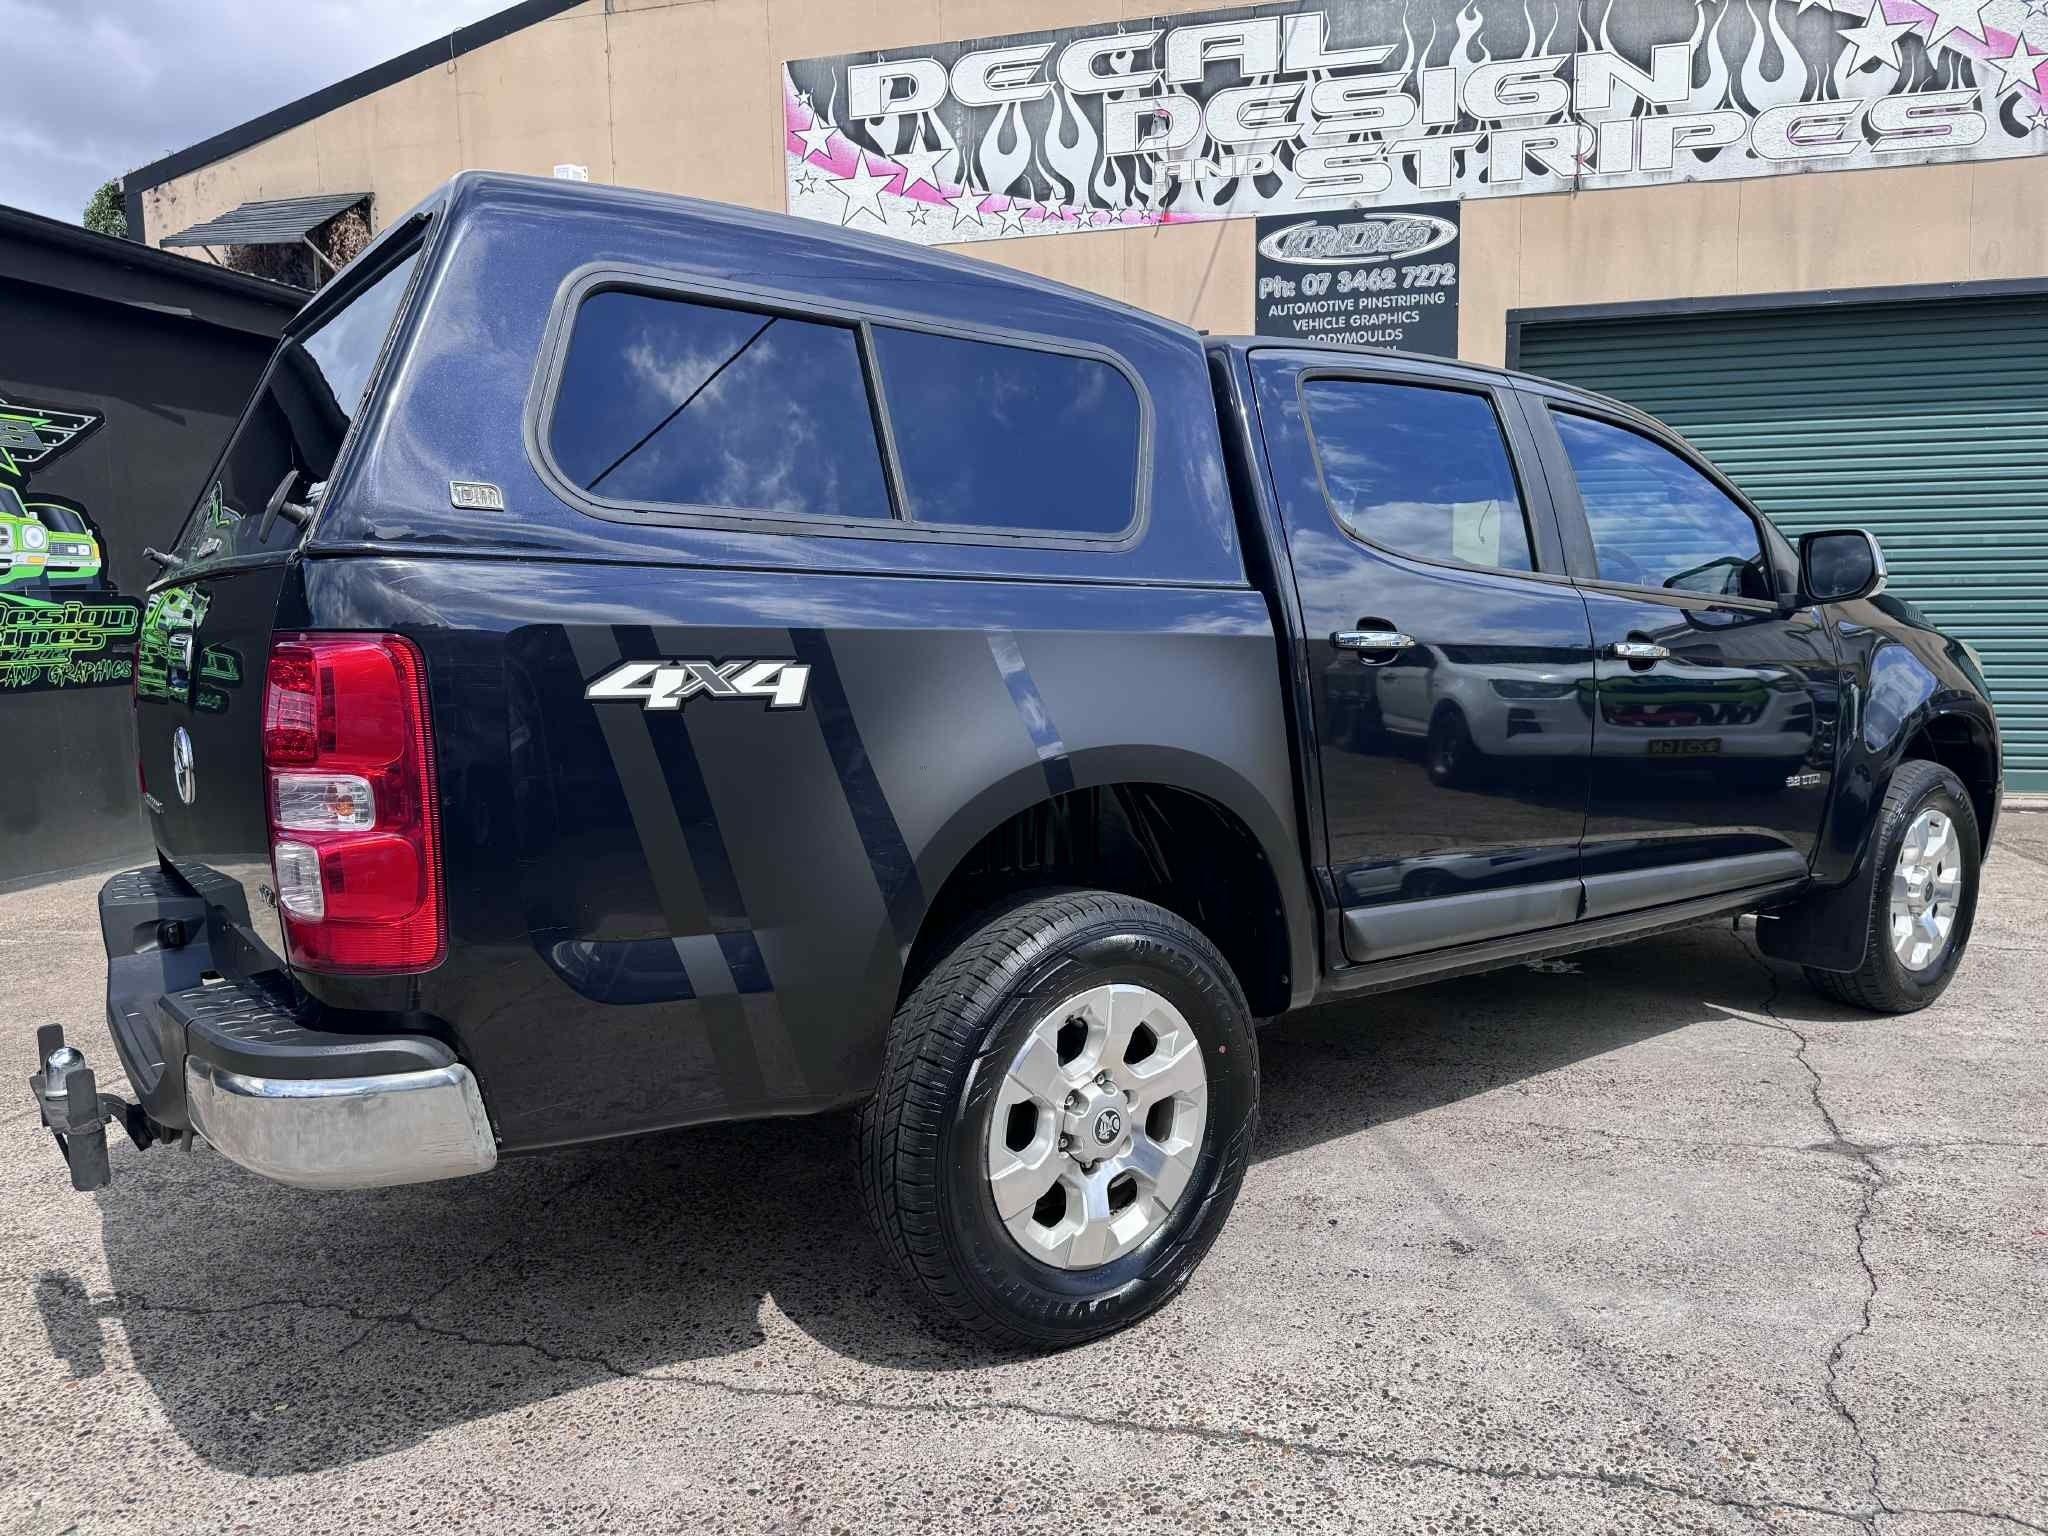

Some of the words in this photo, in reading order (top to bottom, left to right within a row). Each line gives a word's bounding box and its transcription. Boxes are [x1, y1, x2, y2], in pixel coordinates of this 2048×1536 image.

[847, 11, 1400, 120] DECAL
[1104, 42, 1694, 157] DESIGN
[1293, 88, 1988, 200] STRIPES
[1259, 275, 1296, 299] Ph:
[1301, 272, 1332, 296] 07
[1337, 267, 1397, 293] 3462
[1401, 262, 1456, 288] 7272
[1268, 298, 1355, 317] AUTOMOTIVE
[1359, 292, 1446, 310] PINSTRIPING
[1293, 316, 1346, 332] VEHICLE
[1350, 310, 1420, 327] GRAPHICS
[0, 603, 138, 629] esign
[48, 659, 132, 687] GRAPHICS
